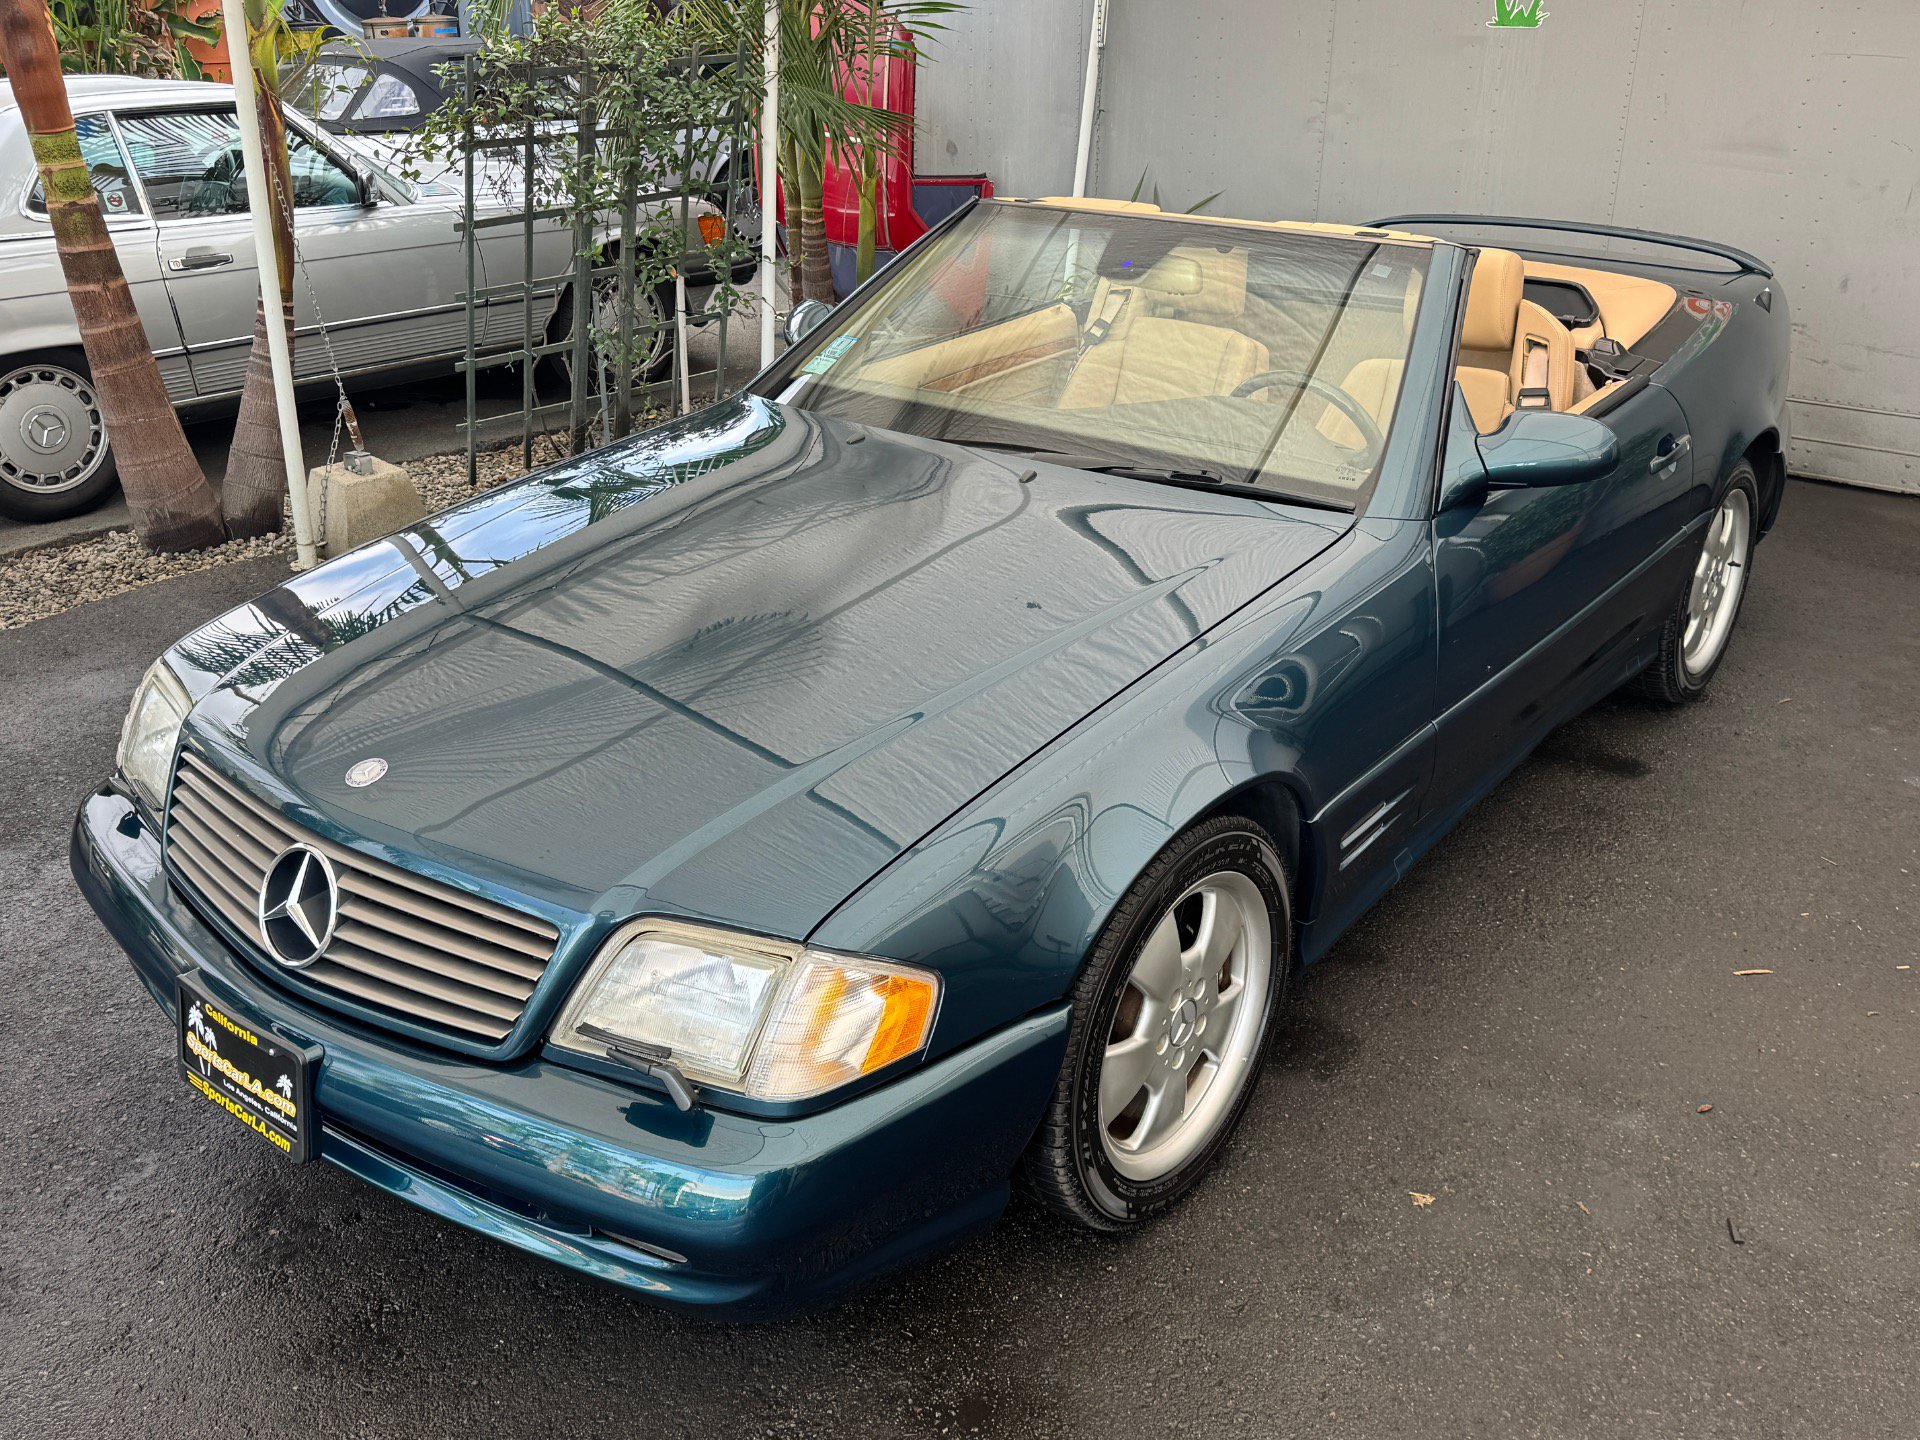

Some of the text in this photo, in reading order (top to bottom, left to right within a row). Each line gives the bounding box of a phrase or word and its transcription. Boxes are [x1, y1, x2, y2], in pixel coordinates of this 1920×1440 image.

[205, 1003, 258, 1046] California
[186, 1031, 297, 1118] SportsCarLA.com
[223, 1078, 298, 1132] Los Angeles, California
[202, 1081, 291, 1153] SportsCarLA.com
